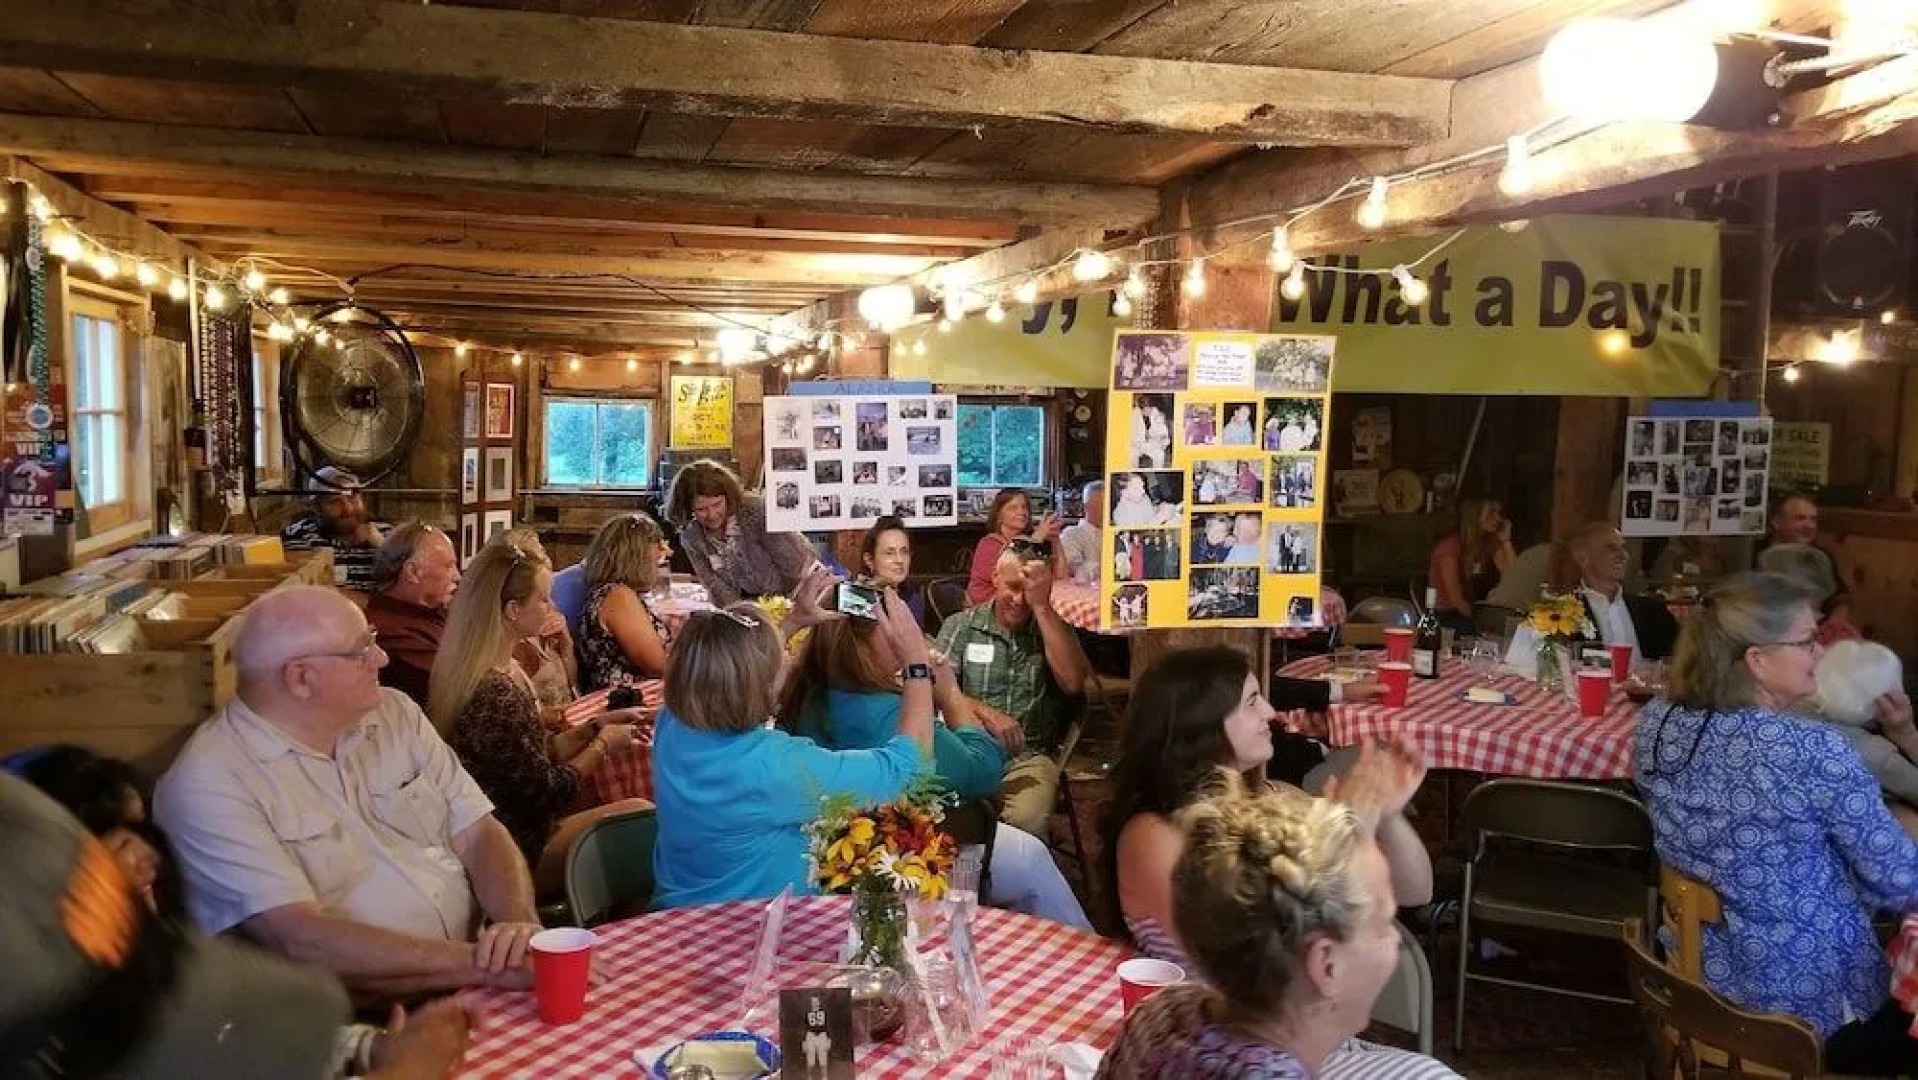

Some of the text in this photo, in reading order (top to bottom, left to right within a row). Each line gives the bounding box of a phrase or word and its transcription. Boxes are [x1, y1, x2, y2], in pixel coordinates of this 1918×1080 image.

[1279, 254, 1452, 325] What
[1474, 275, 1514, 327] a
[1538, 260, 1702, 348] Day!!
[835, 382, 897, 395] ALASKA
[9, 494, 49, 507] VIP
[807, 1010, 826, 1027] 69
